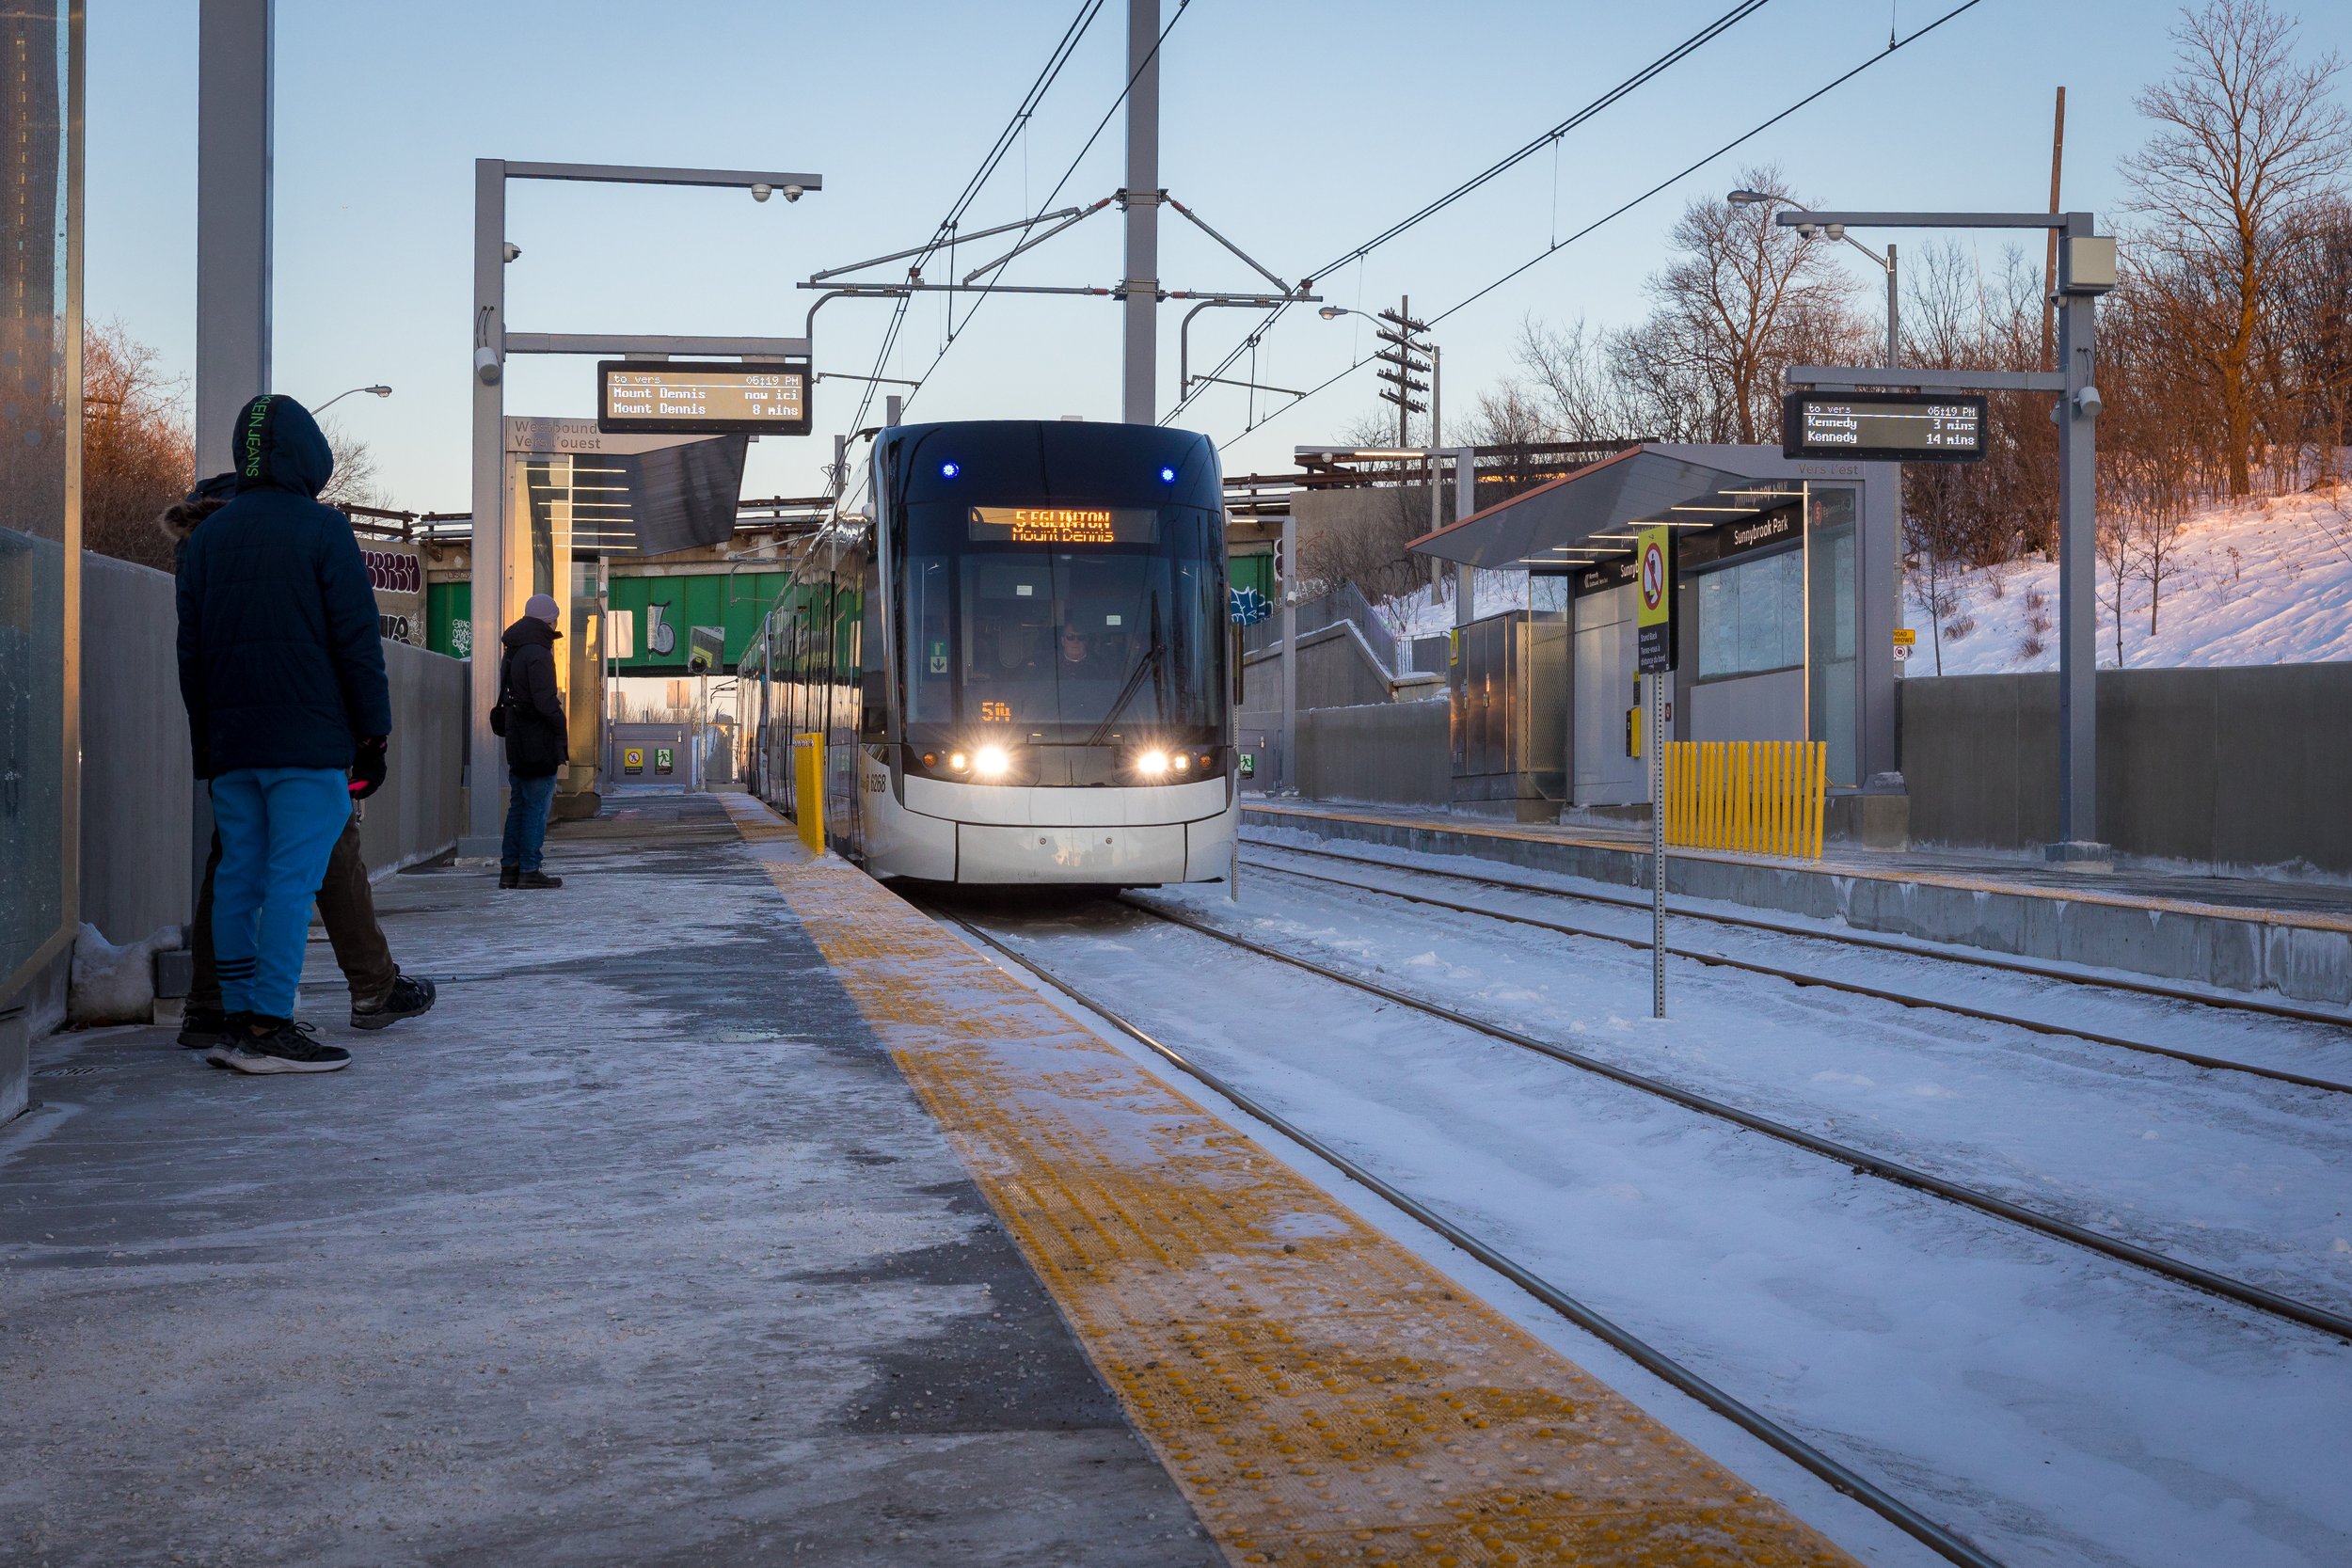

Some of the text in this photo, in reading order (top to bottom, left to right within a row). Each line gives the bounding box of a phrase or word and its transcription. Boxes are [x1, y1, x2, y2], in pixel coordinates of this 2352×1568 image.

[613, 373, 799, 387] to vers 05:19 PM
[613, 387, 799, 401] Mount Dennis now ici
[613, 403, 799, 416] Mount Dennis 8 mins
[1808, 404, 1821, 413] to
[1827, 405, 1851, 414] vers
[1963, 406, 1976, 417] PM
[515, 420, 597, 434] Westbound
[1807, 416, 1975, 431] Kennedy 3 mins
[515, 436, 546, 447] Vers
[1807, 430, 1975, 445] Kennedy 14 mins
[246, 429, 261, 477] JEANS
[1798, 464, 1828, 475] Vers
[1016, 511, 1110, 529] 5 EGLINTON
[1012, 527, 1114, 543] Mount Dennis
[1734, 515, 1788, 546] Sunnybrook Park
[870, 773, 886, 793] 6268
